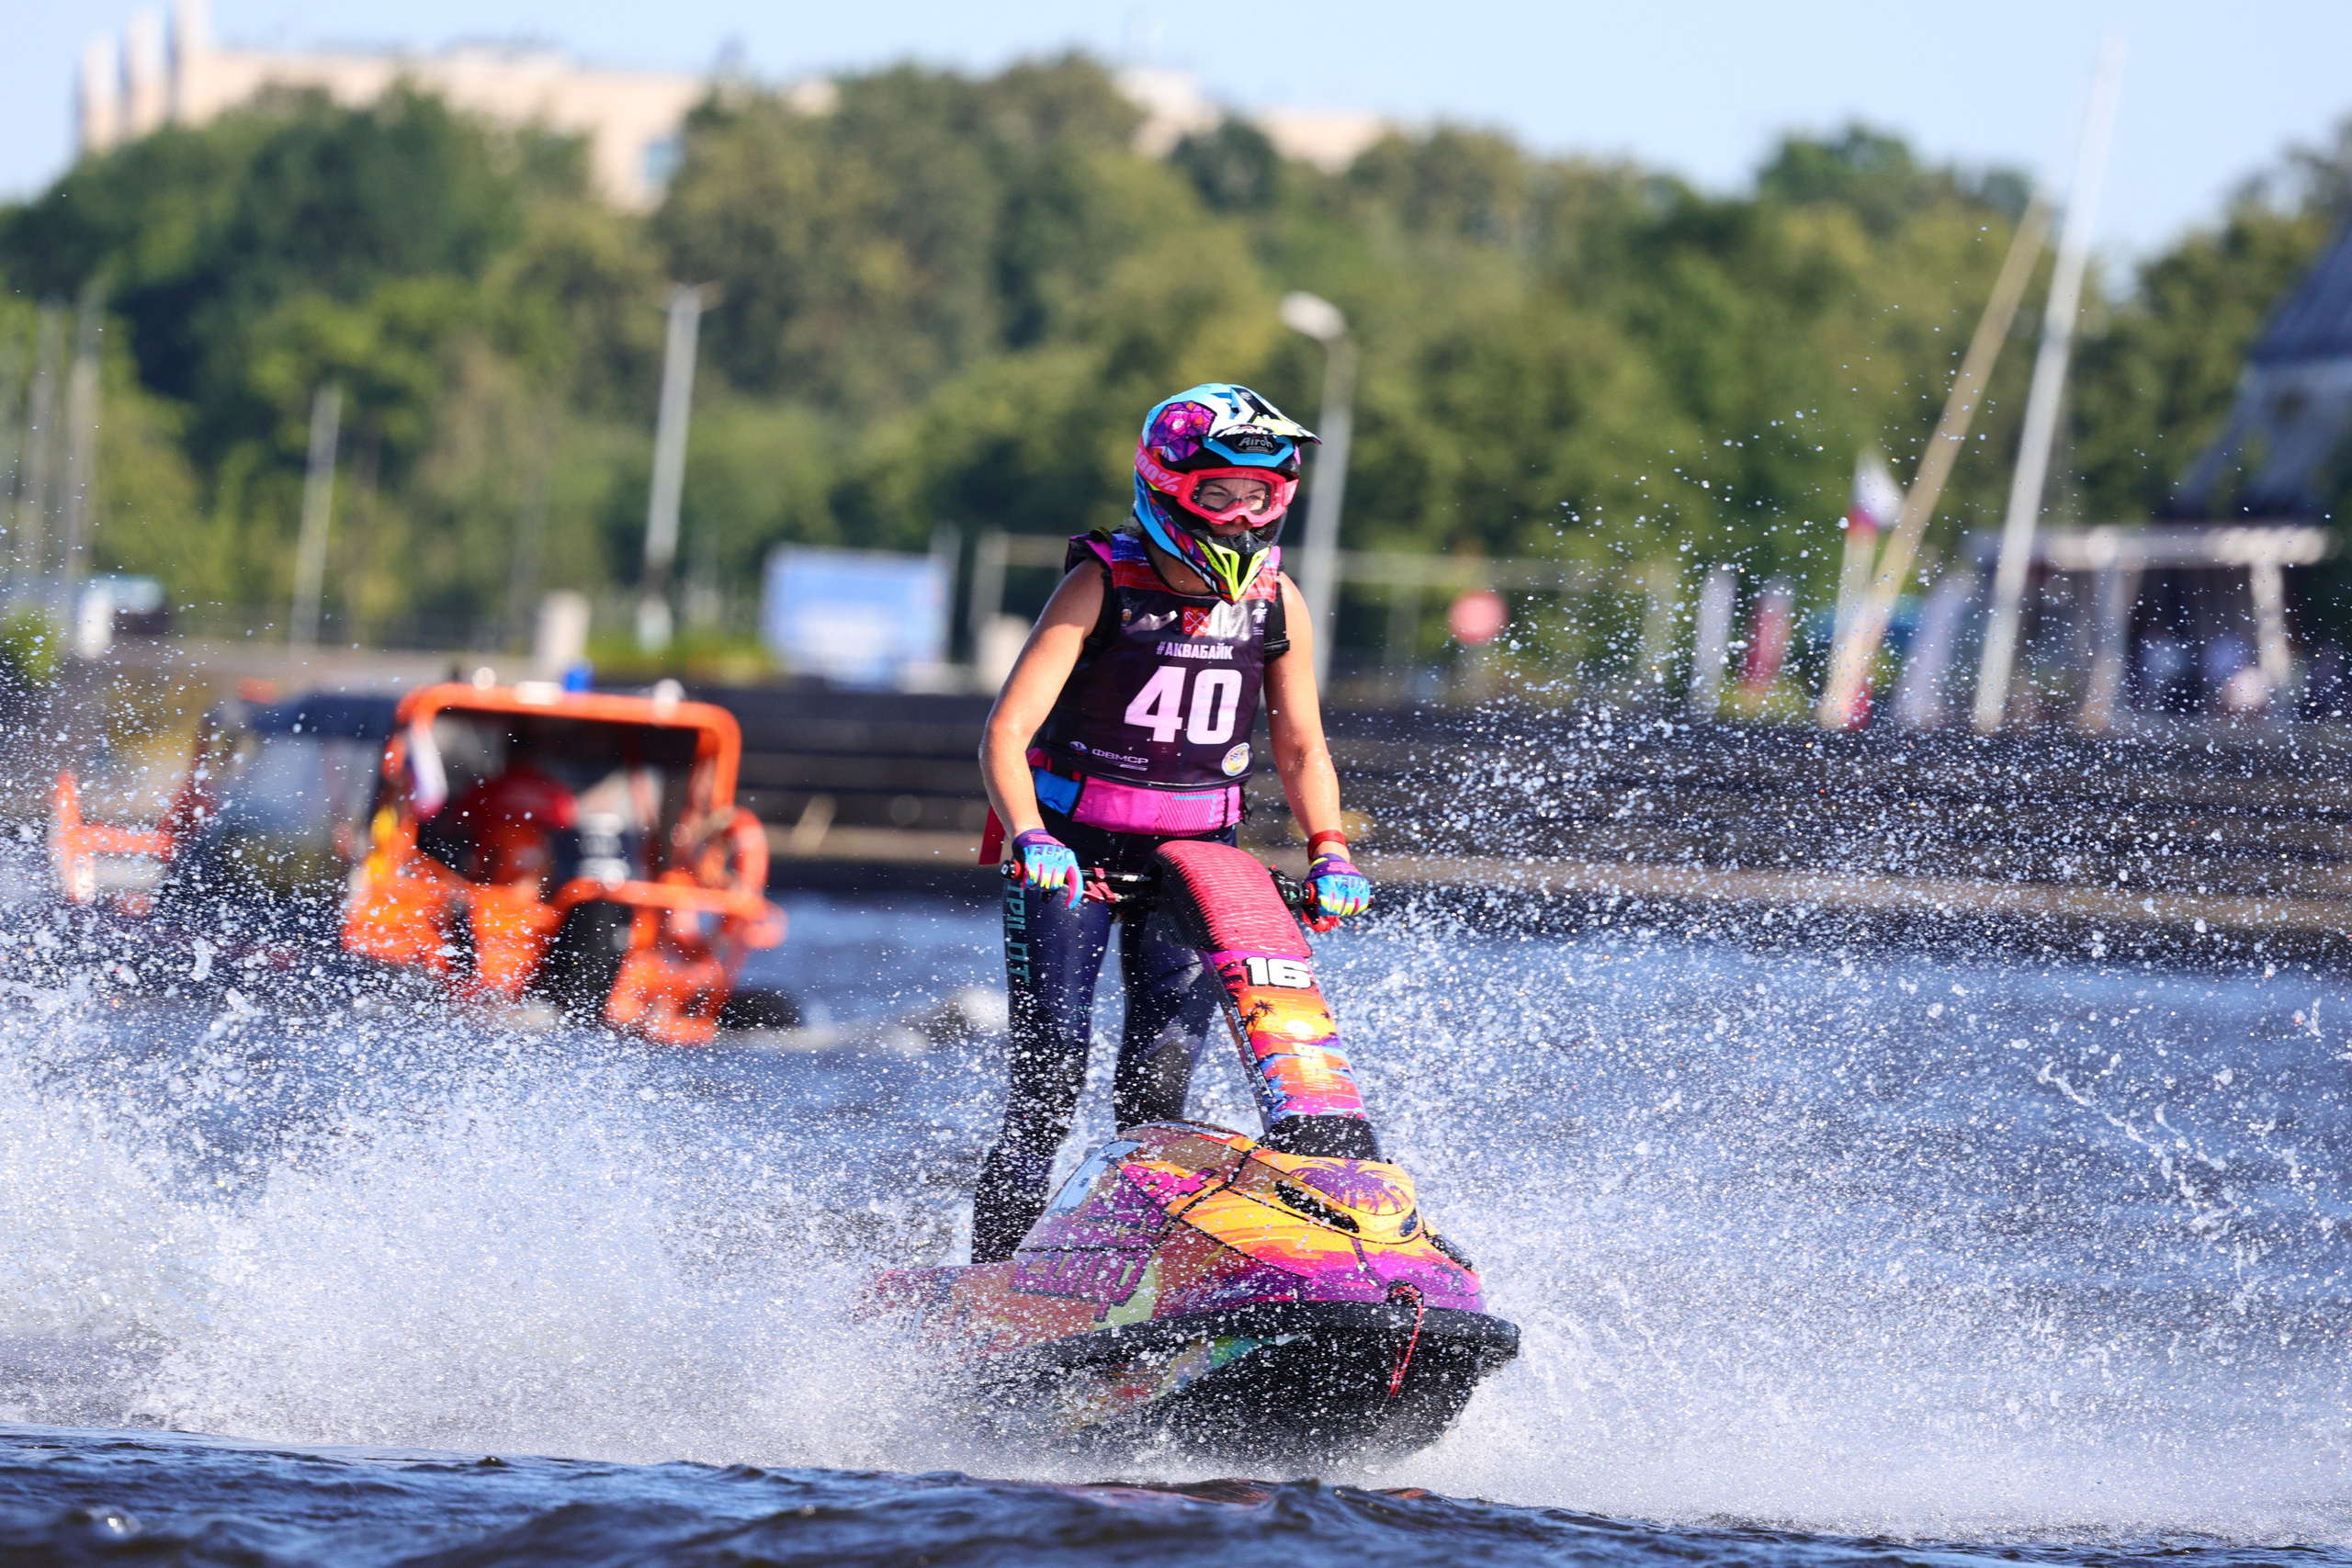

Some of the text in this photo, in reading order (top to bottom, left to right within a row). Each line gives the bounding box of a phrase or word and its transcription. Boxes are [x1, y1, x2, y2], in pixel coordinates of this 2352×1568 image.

[1216, 425, 1269, 437] Airoh
[1238, 434, 1273, 448] Airoh
[1156, 641, 1234, 660] #АКВАБАЙК
[1125, 666, 1242, 745] 40
[1091, 749, 1149, 764] ФВМСР
[1246, 956, 1311, 988] 16
